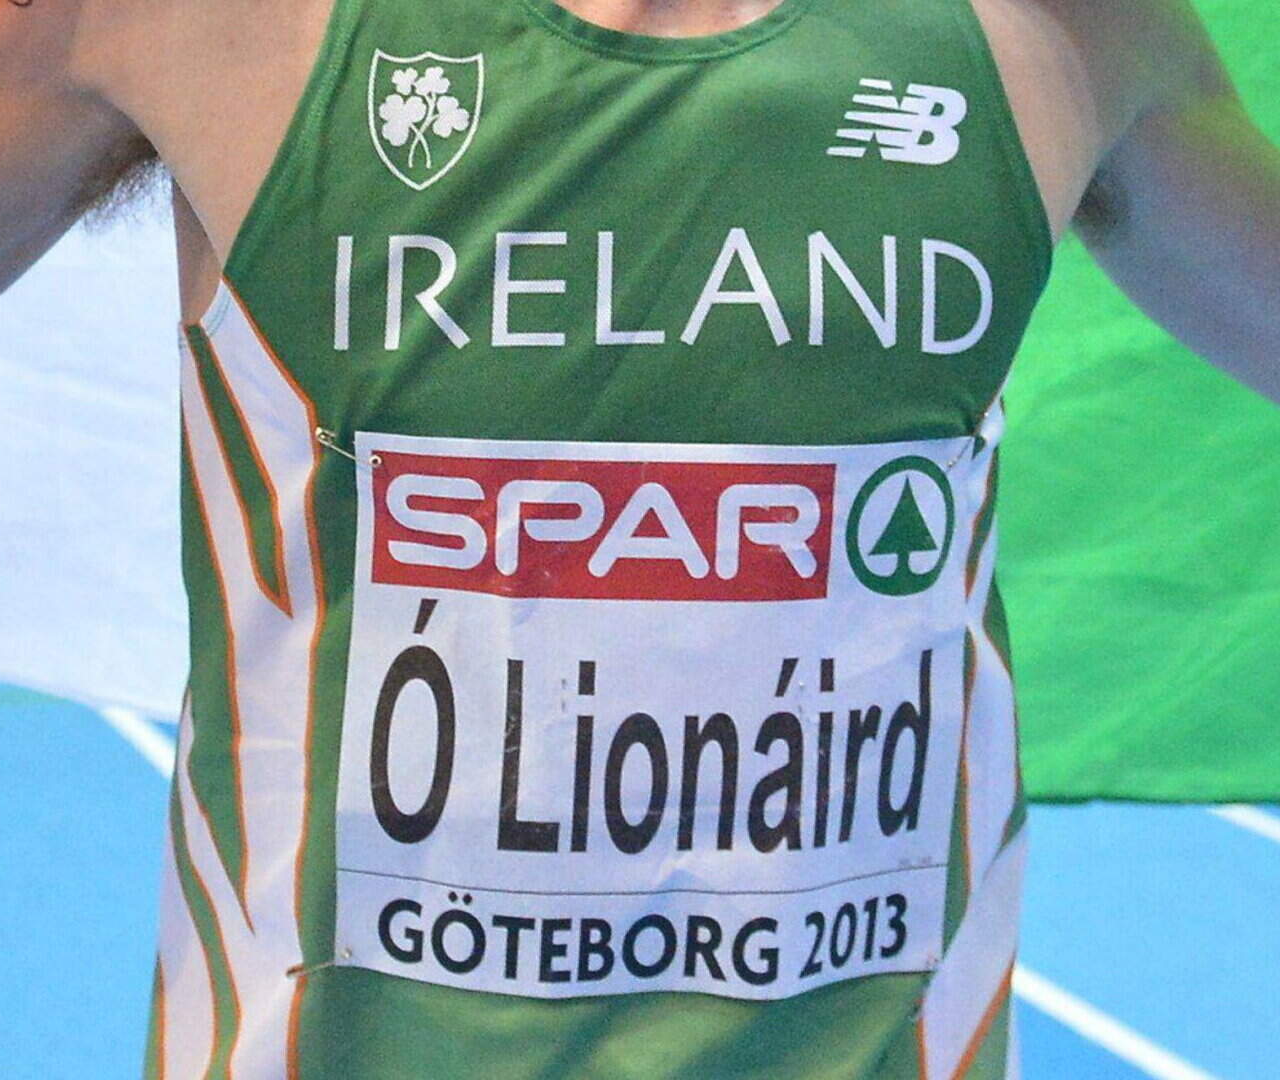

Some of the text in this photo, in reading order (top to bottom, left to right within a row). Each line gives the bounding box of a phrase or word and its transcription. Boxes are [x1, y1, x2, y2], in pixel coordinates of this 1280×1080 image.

[826, 78, 968, 165] NB
[333, 228, 994, 354] IRELAND
[385, 474, 821, 579] SPAR
[370, 599, 933, 854] Ó Lionáird
[377, 892, 908, 985] GÖTEBORG 2013
